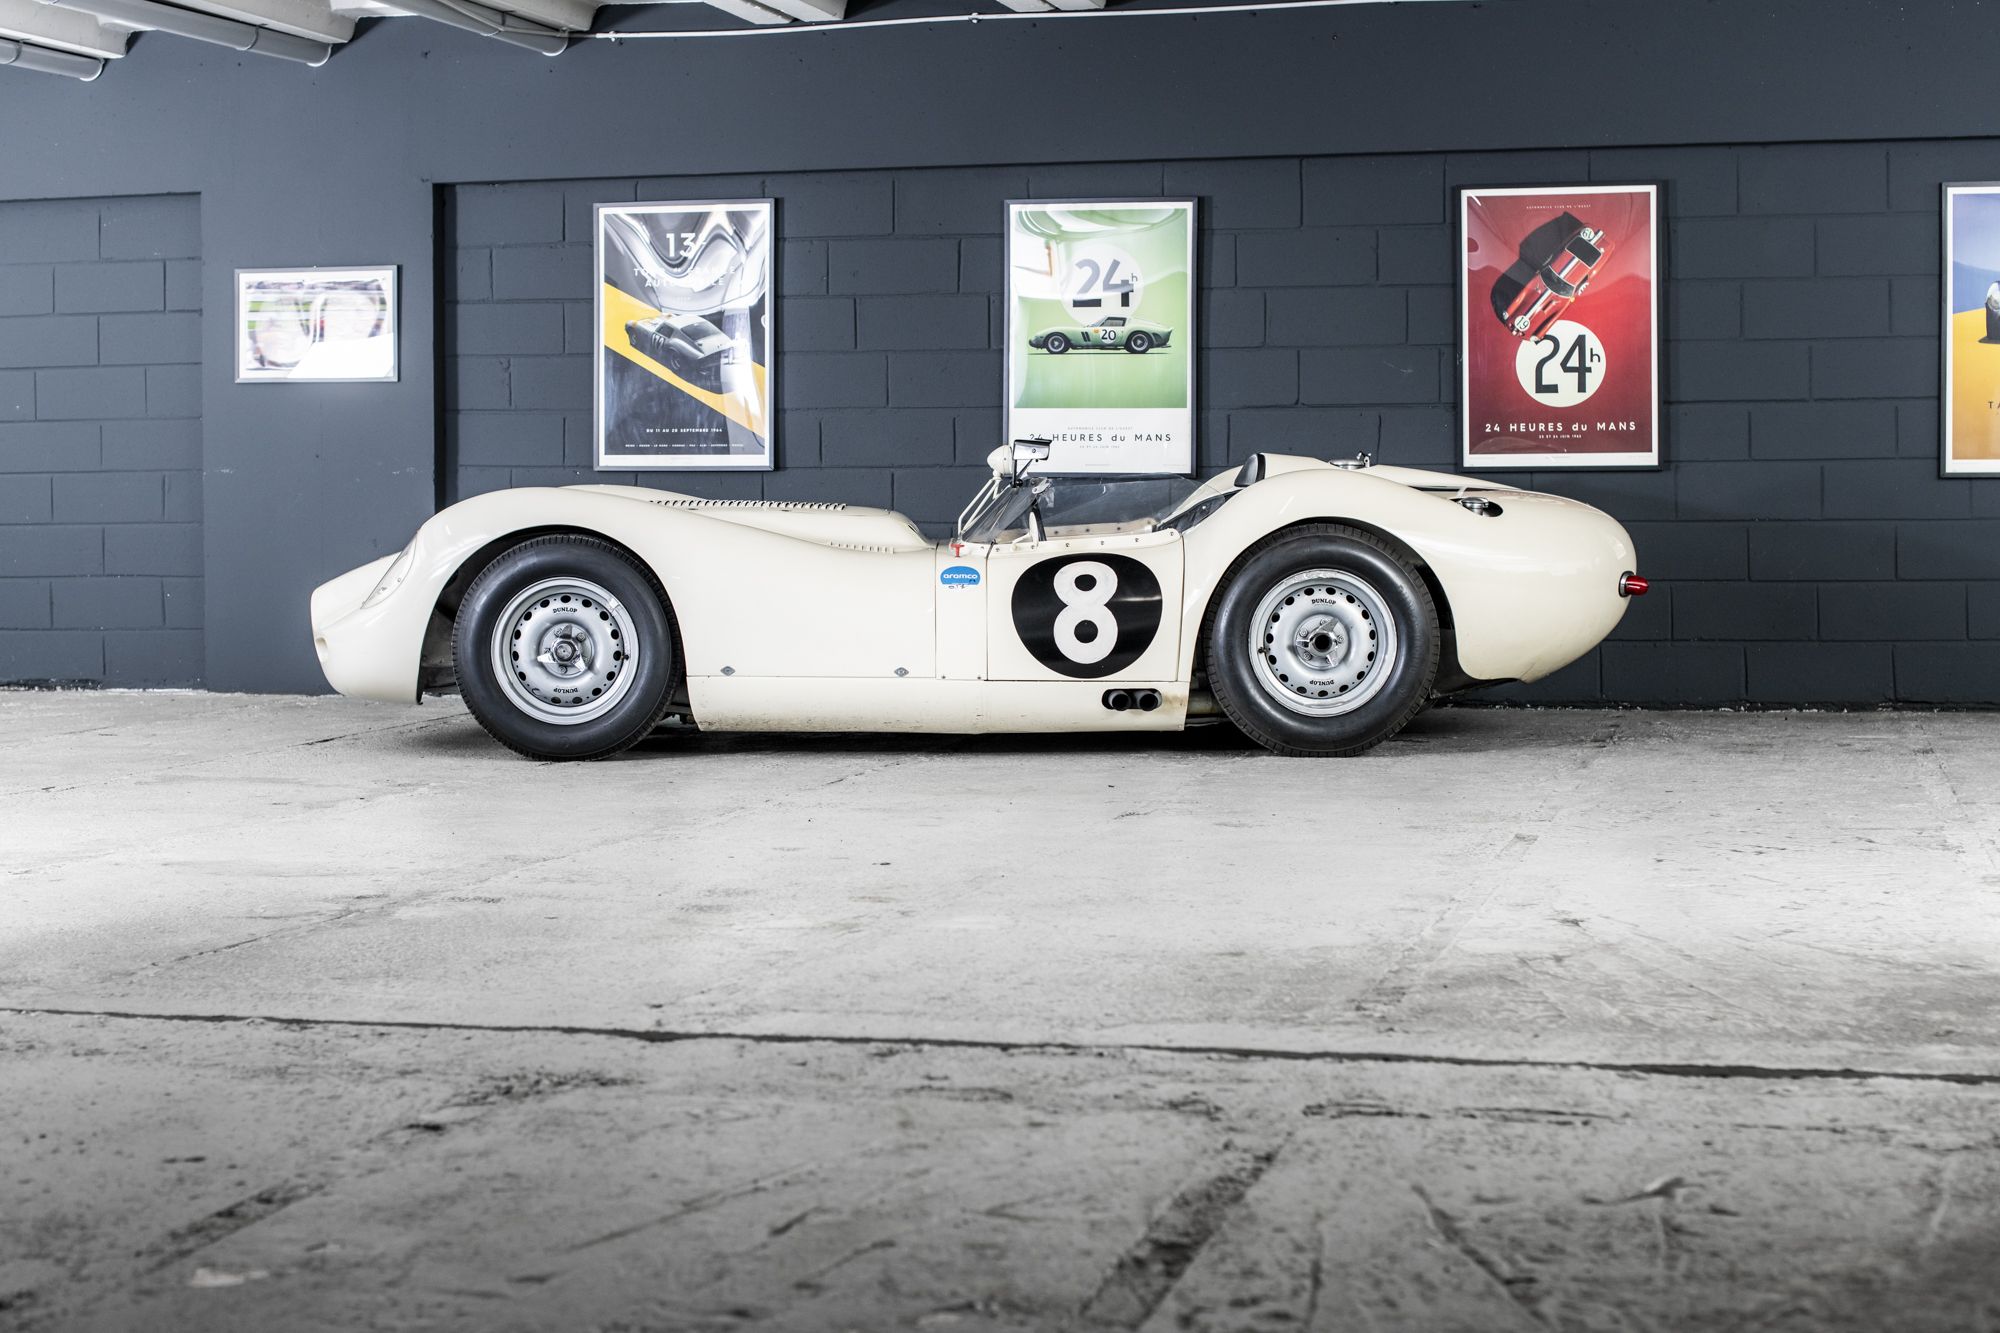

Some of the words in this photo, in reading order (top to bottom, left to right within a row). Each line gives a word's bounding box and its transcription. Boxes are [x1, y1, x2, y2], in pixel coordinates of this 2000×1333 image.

[1101, 329, 1117, 341] 20
[1533, 334, 1601, 393] 24h
[1485, 423, 1500, 432] 24
[1509, 422, 1563, 432] HEURES
[1571, 422, 1588, 431] du
[1597, 421, 1636, 431] MANS
[1052, 433, 1103, 442] HEURES
[1111, 433, 1126, 442] du
[1134, 433, 1171, 442] MANS
[1053, 560, 1119, 664] 8
[553, 686, 579, 694] DUNLOP
